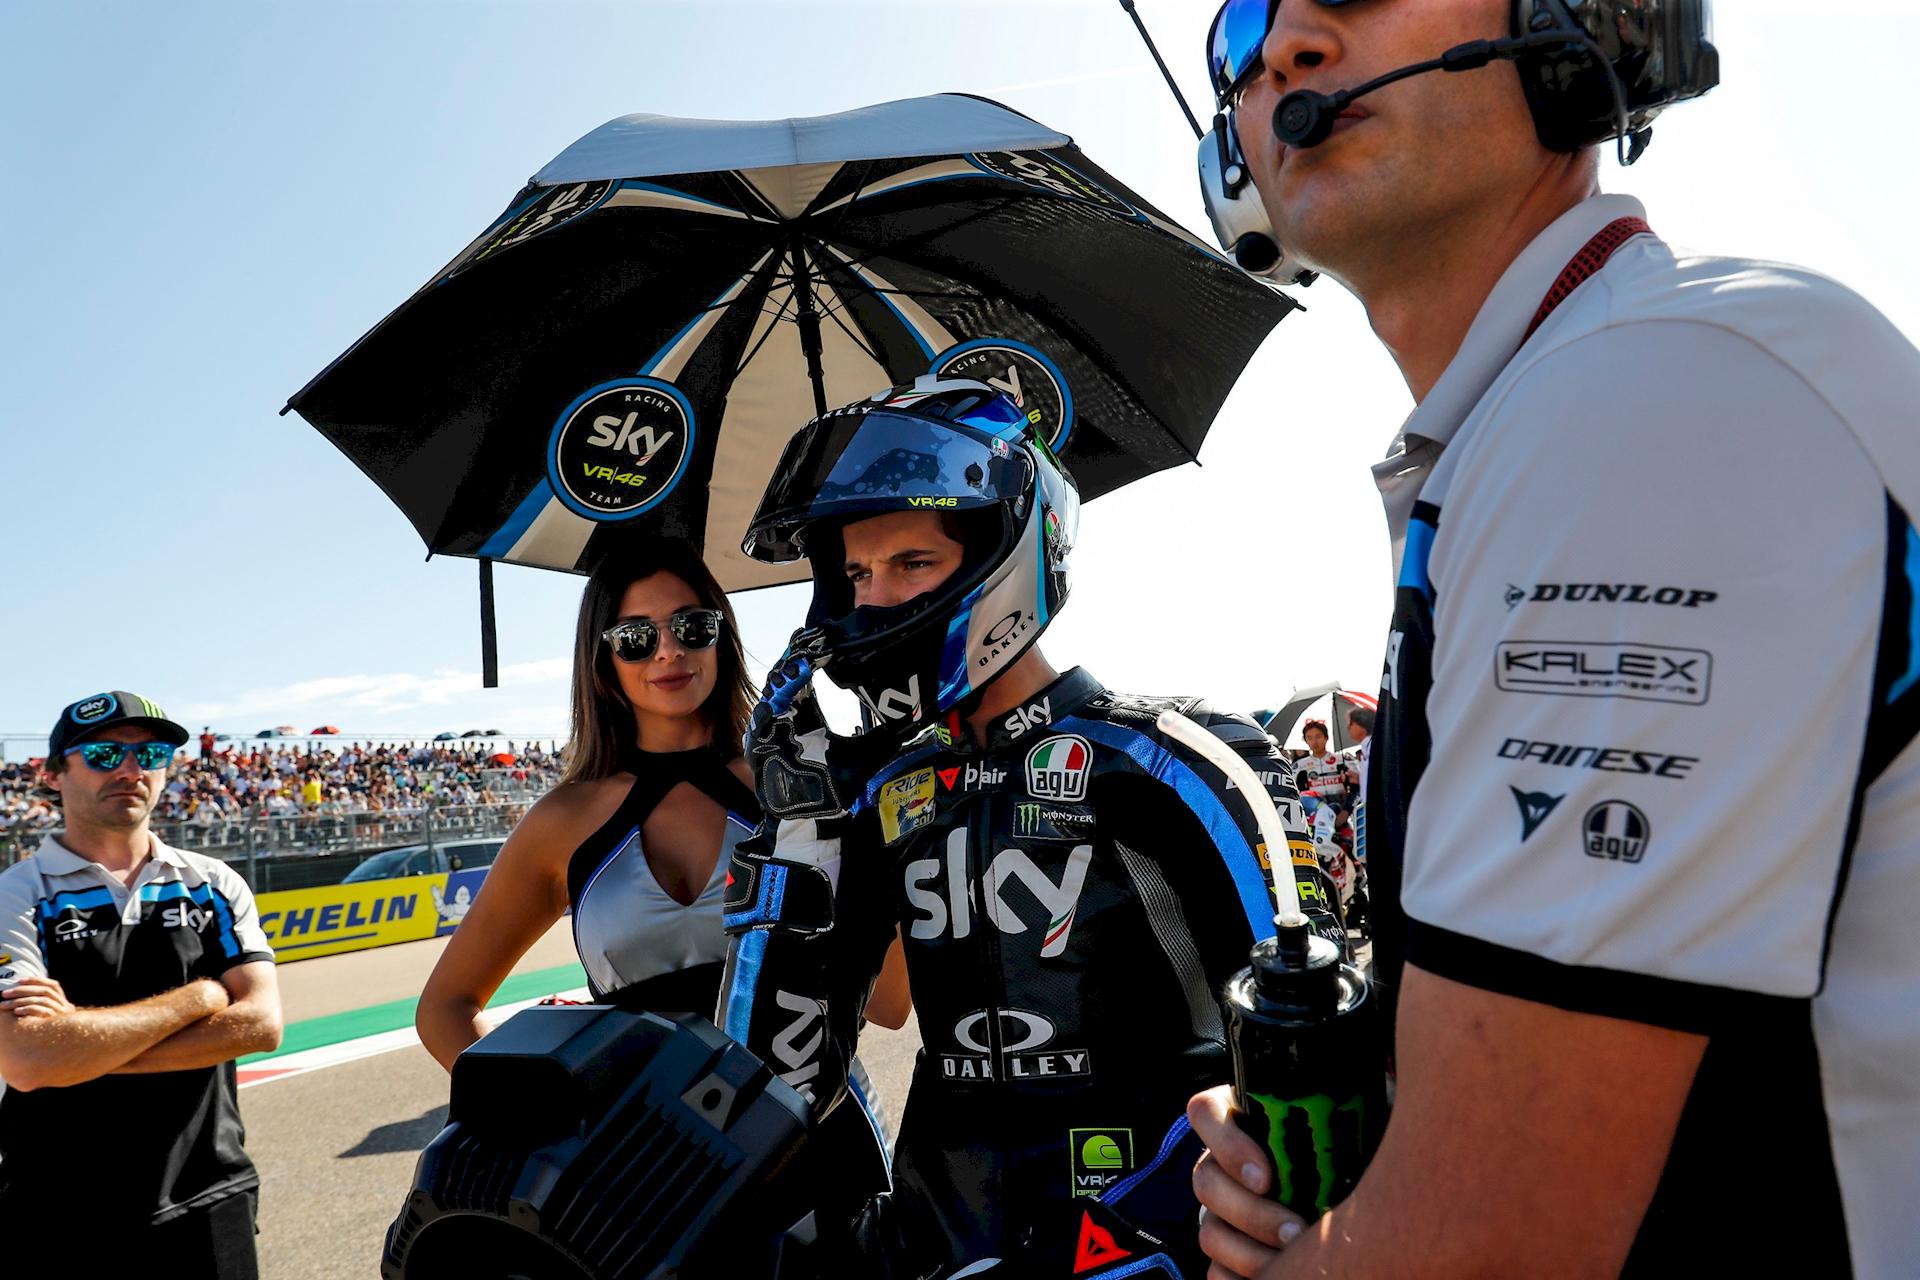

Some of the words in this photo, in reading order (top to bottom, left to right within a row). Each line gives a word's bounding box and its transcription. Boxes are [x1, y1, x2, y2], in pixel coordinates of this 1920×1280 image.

[950, 355, 987, 375] ACING
[624, 395, 671, 413] RACING
[586, 412, 674, 466] sky
[589, 492, 622, 504] TEAM
[1529, 583, 1720, 608] DUNLOP
[979, 611, 1035, 667] OAKLEY
[1505, 650, 1699, 682] KALEX
[1004, 695, 1052, 740] sky
[1497, 738, 1702, 780] DAINESE
[1034, 771, 1081, 797] agv
[1589, 835, 1642, 860] agv
[904, 826, 1093, 959] sky
[162, 901, 214, 934] sky
[258, 894, 418, 940] CHELIN
[943, 1053, 1086, 1079] OAKLEY
